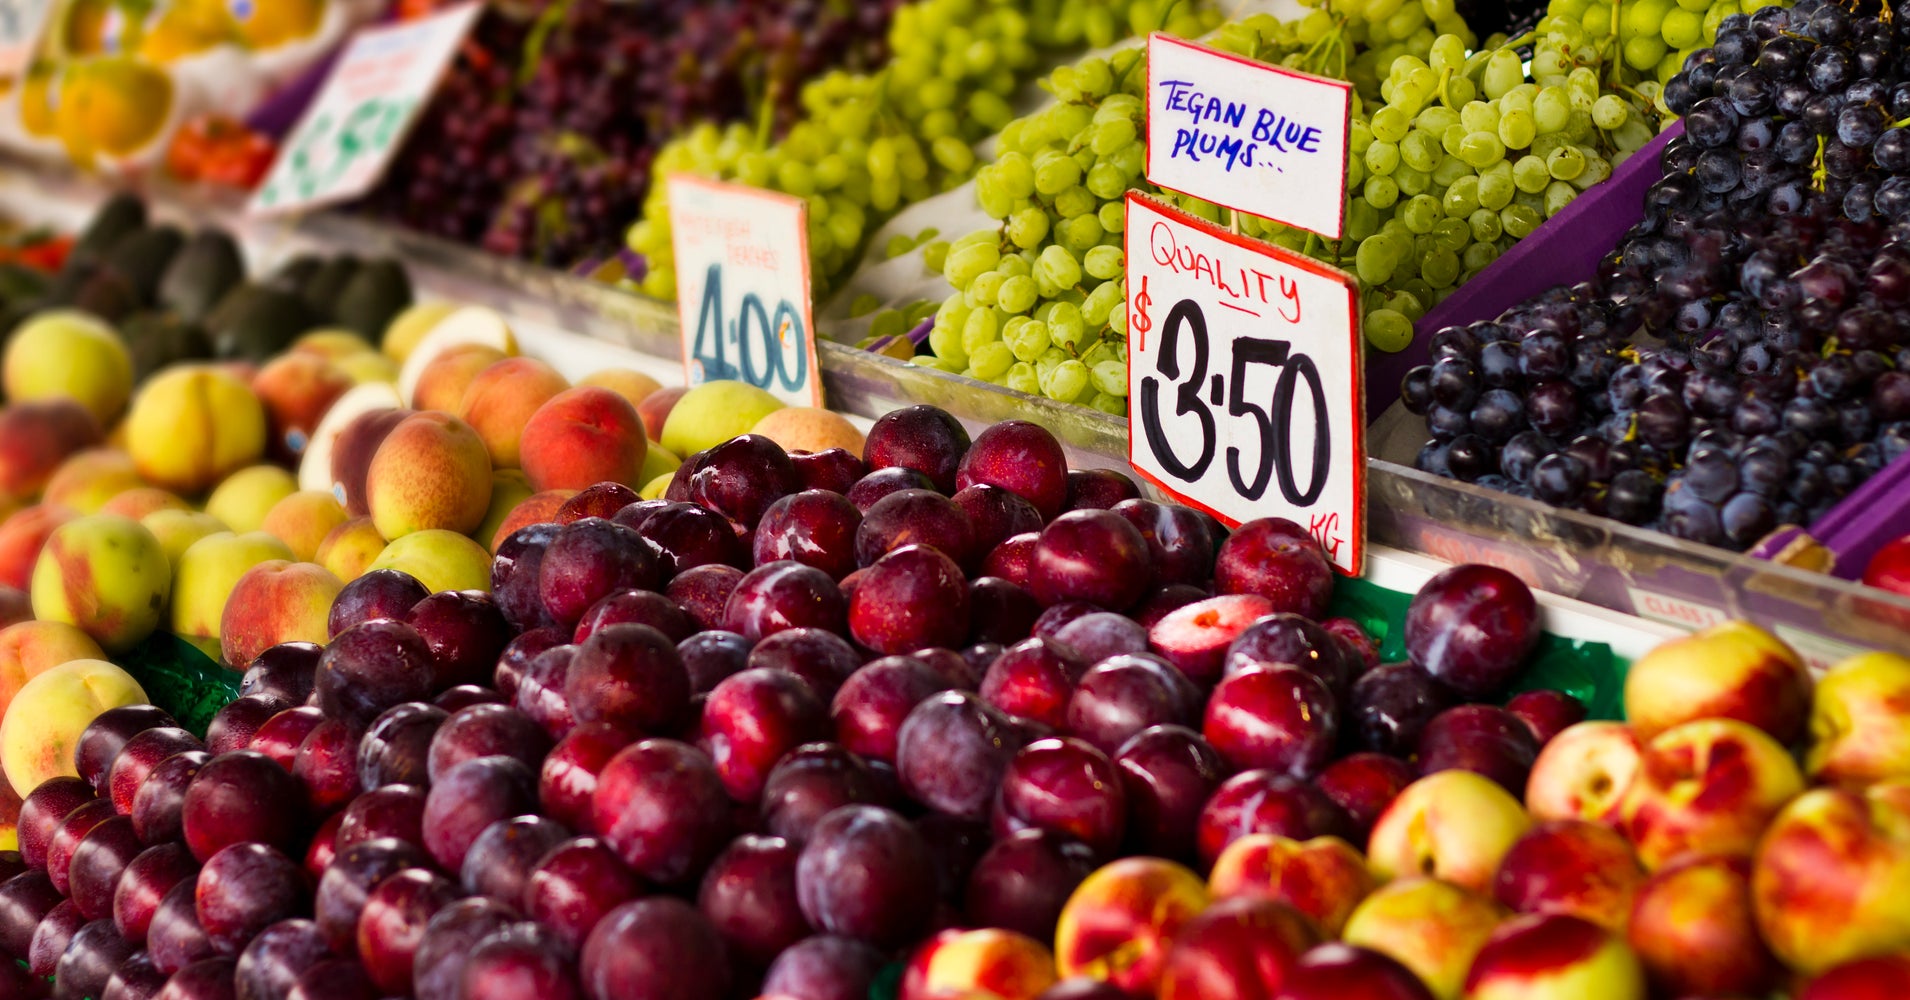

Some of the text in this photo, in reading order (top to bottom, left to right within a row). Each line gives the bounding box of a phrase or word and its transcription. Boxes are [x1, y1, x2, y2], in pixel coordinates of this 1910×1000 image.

[1159, 79, 1322, 153] TEGAN BLUE
[1150, 221, 1302, 325] QUALITY
[1310, 512, 1345, 562] KG
